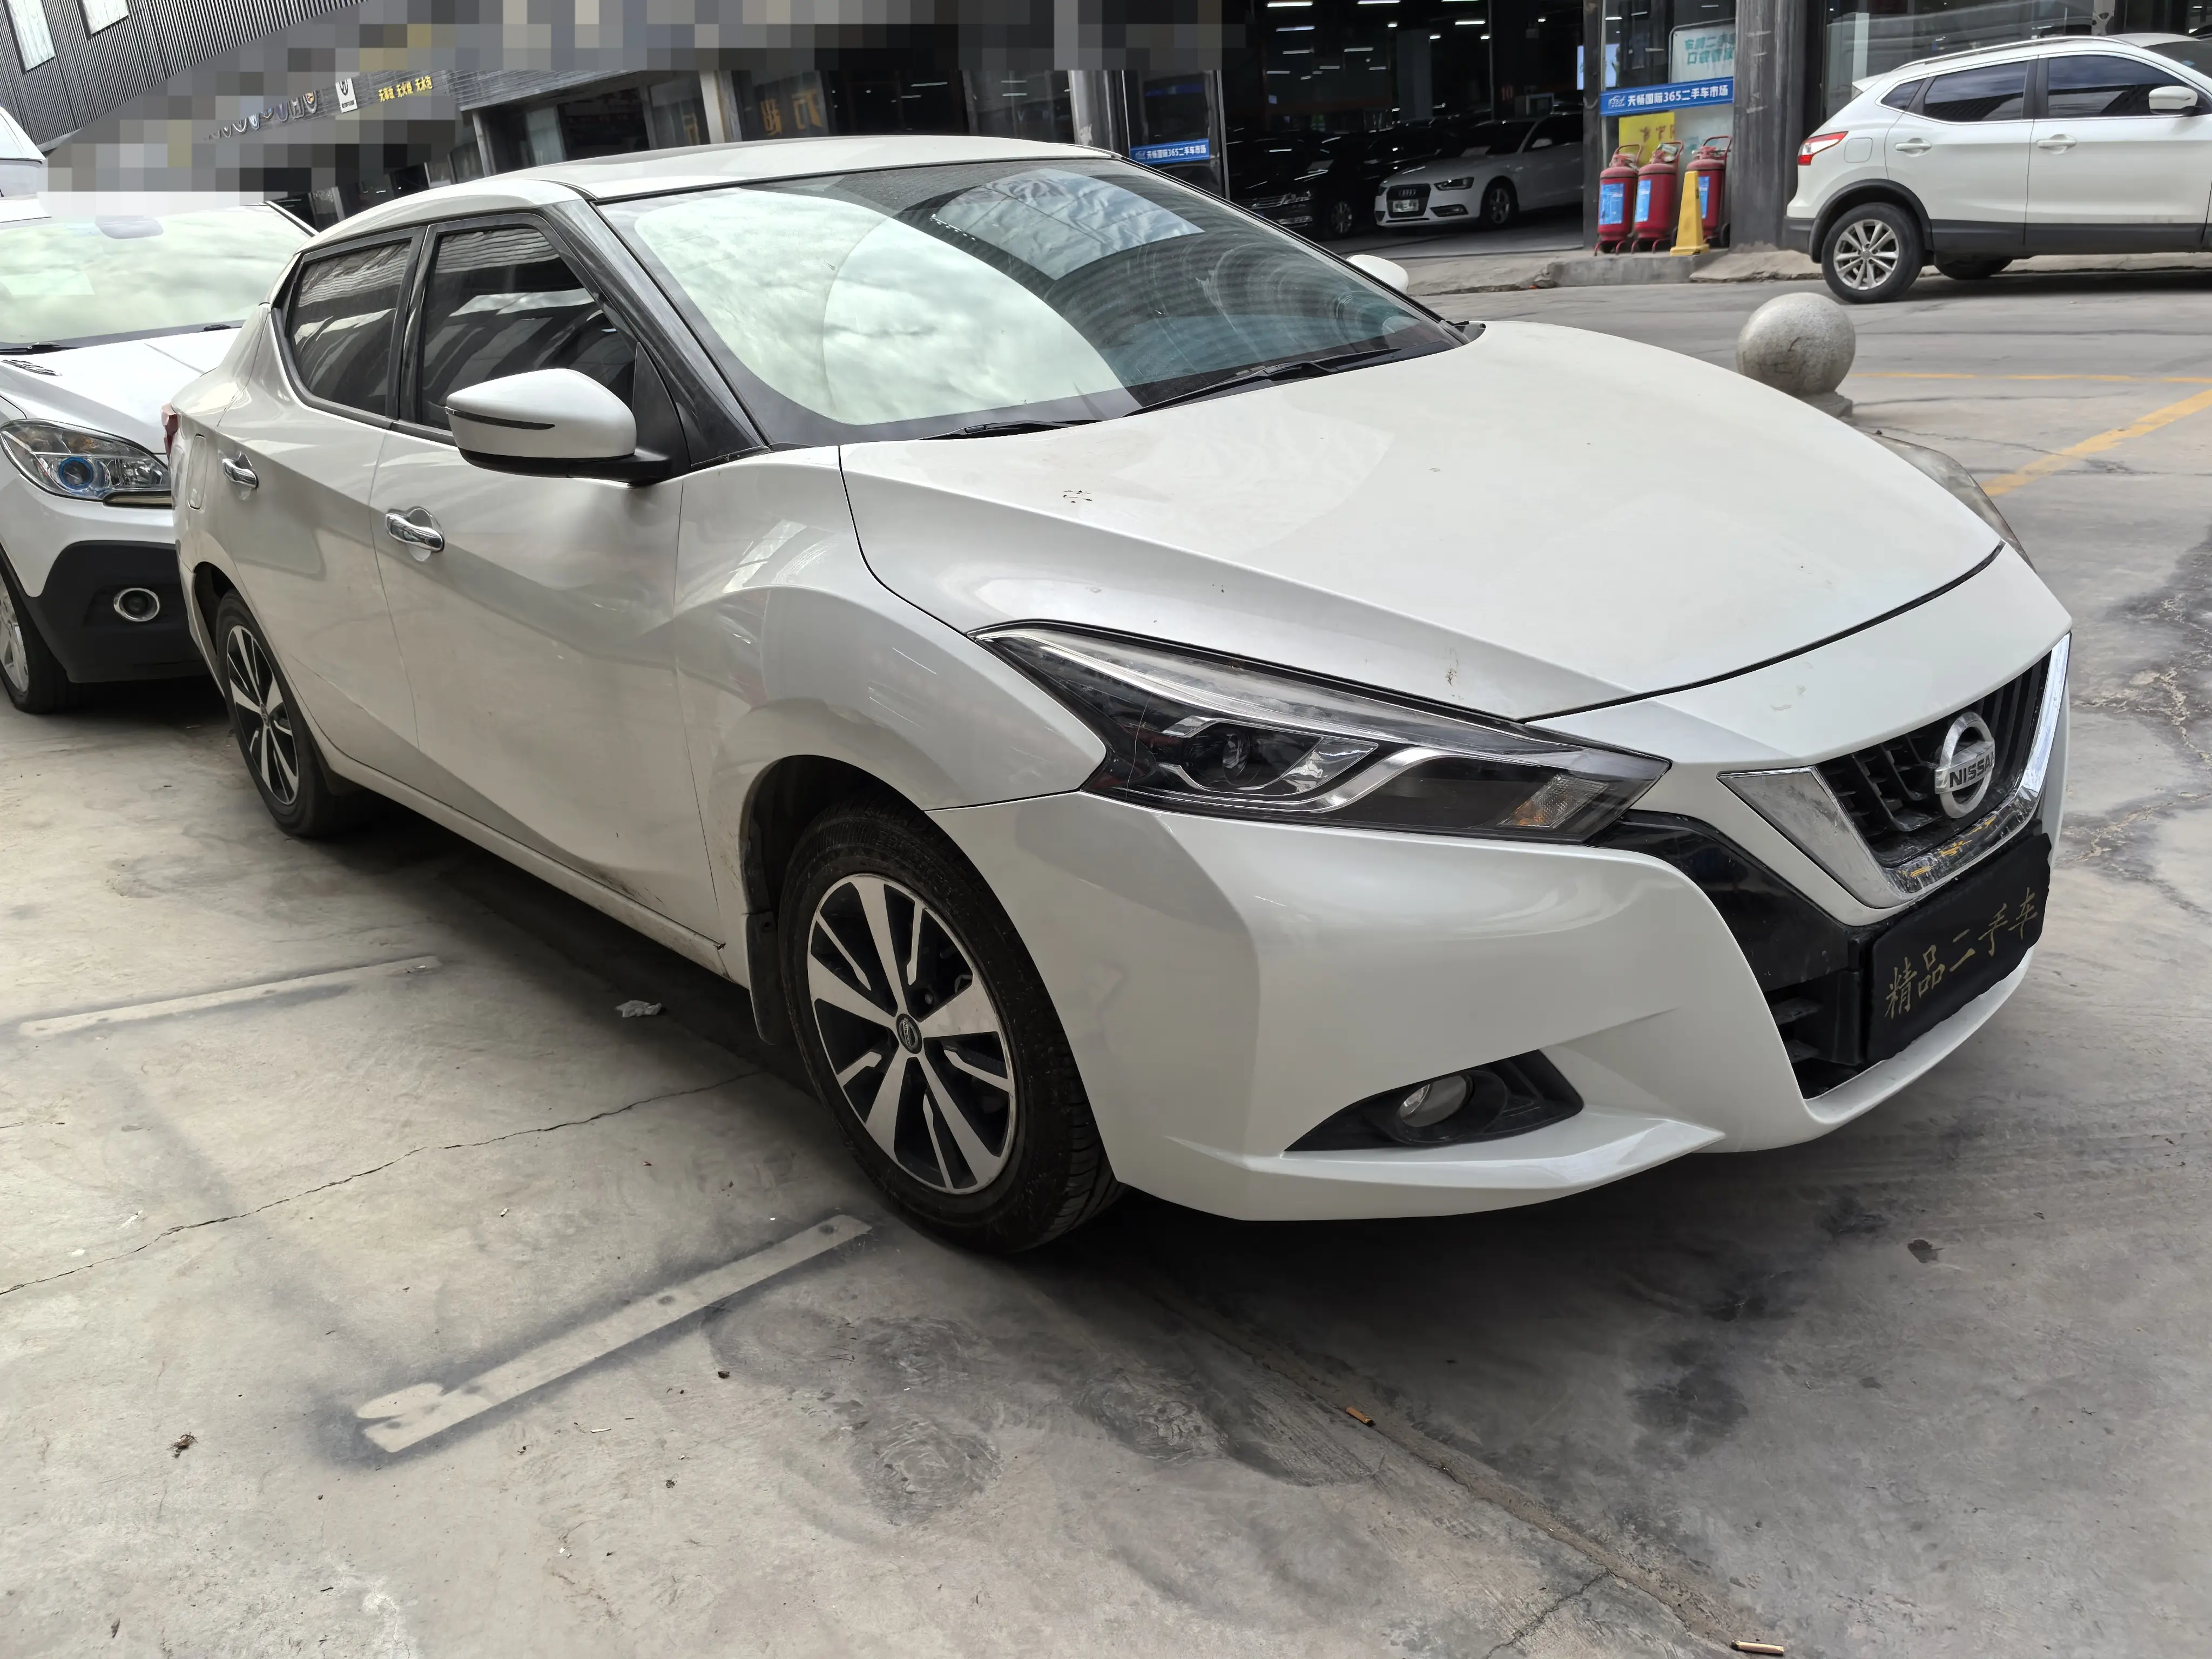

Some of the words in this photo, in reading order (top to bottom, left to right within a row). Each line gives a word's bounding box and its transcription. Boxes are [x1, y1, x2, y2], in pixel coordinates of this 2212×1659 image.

[1949, 751, 1994, 788] NISSAN
[1884, 887, 2038, 1019] 精品二手车
